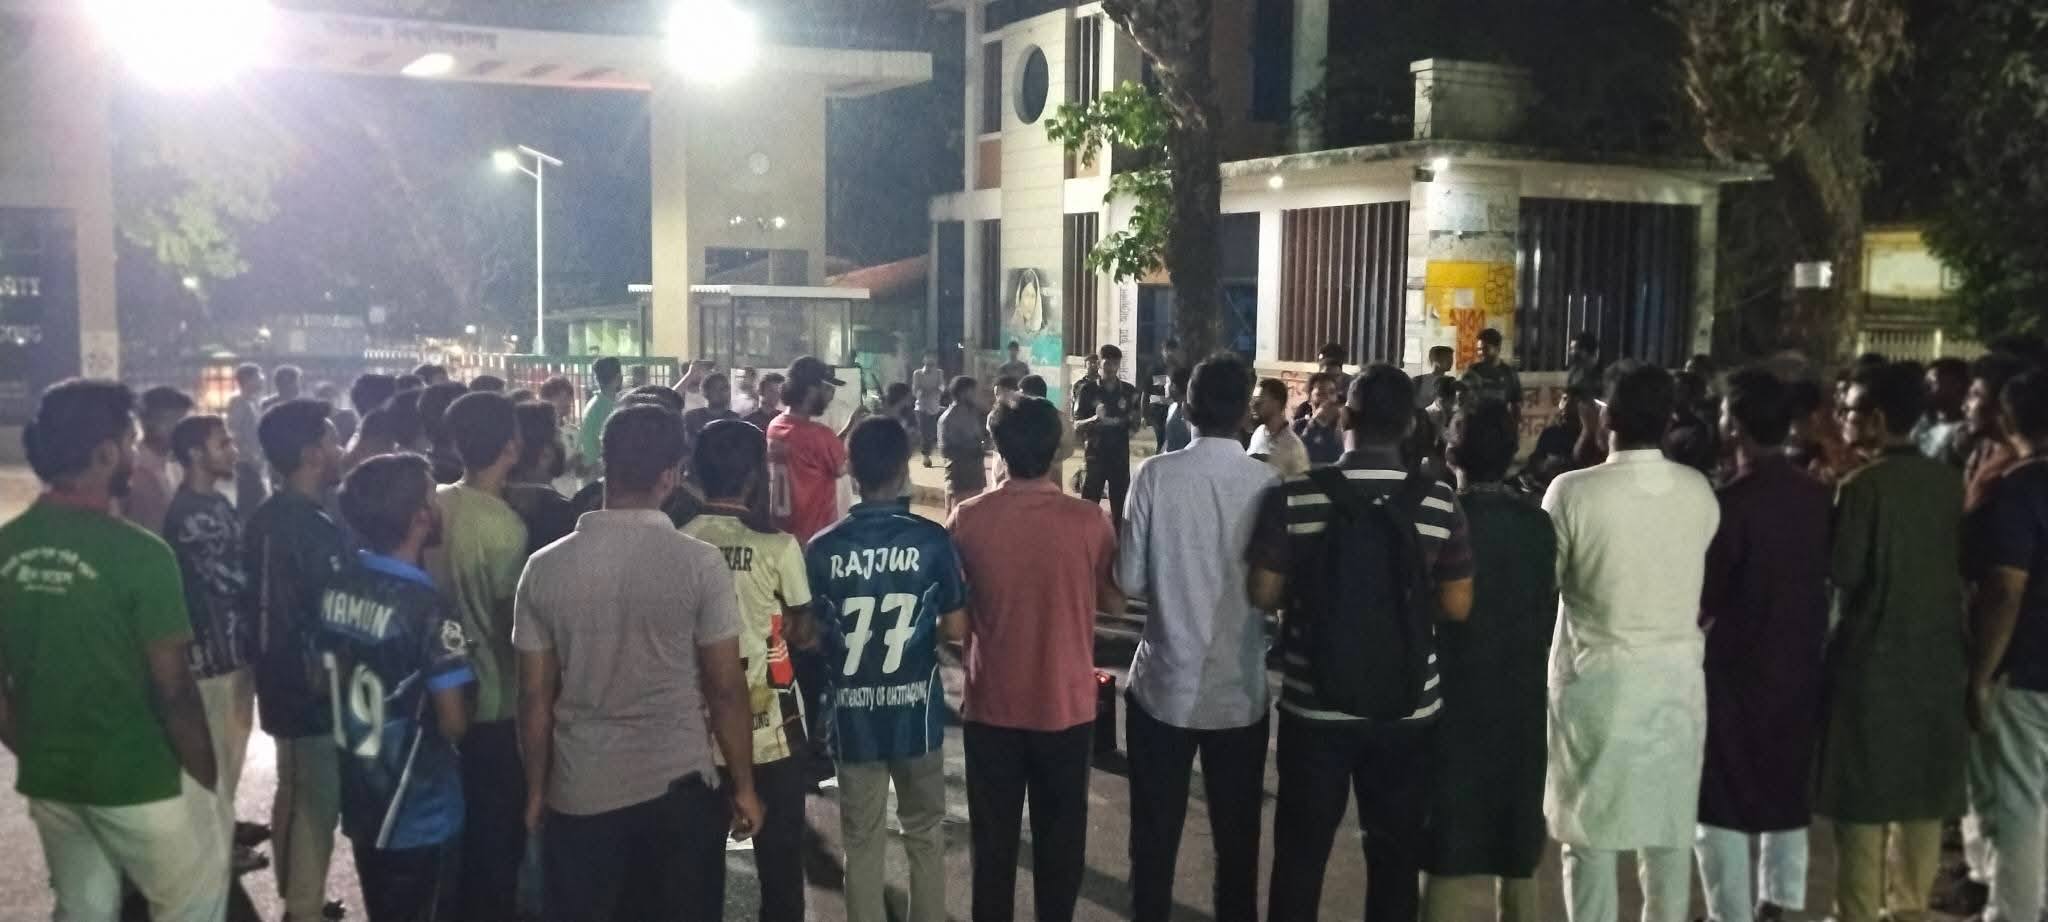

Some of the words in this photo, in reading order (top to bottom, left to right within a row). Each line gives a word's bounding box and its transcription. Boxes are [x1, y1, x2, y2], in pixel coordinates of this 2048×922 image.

[843, 595, 917, 676] 77
[323, 651, 384, 757] 19
[876, 686, 885, 706] OF
